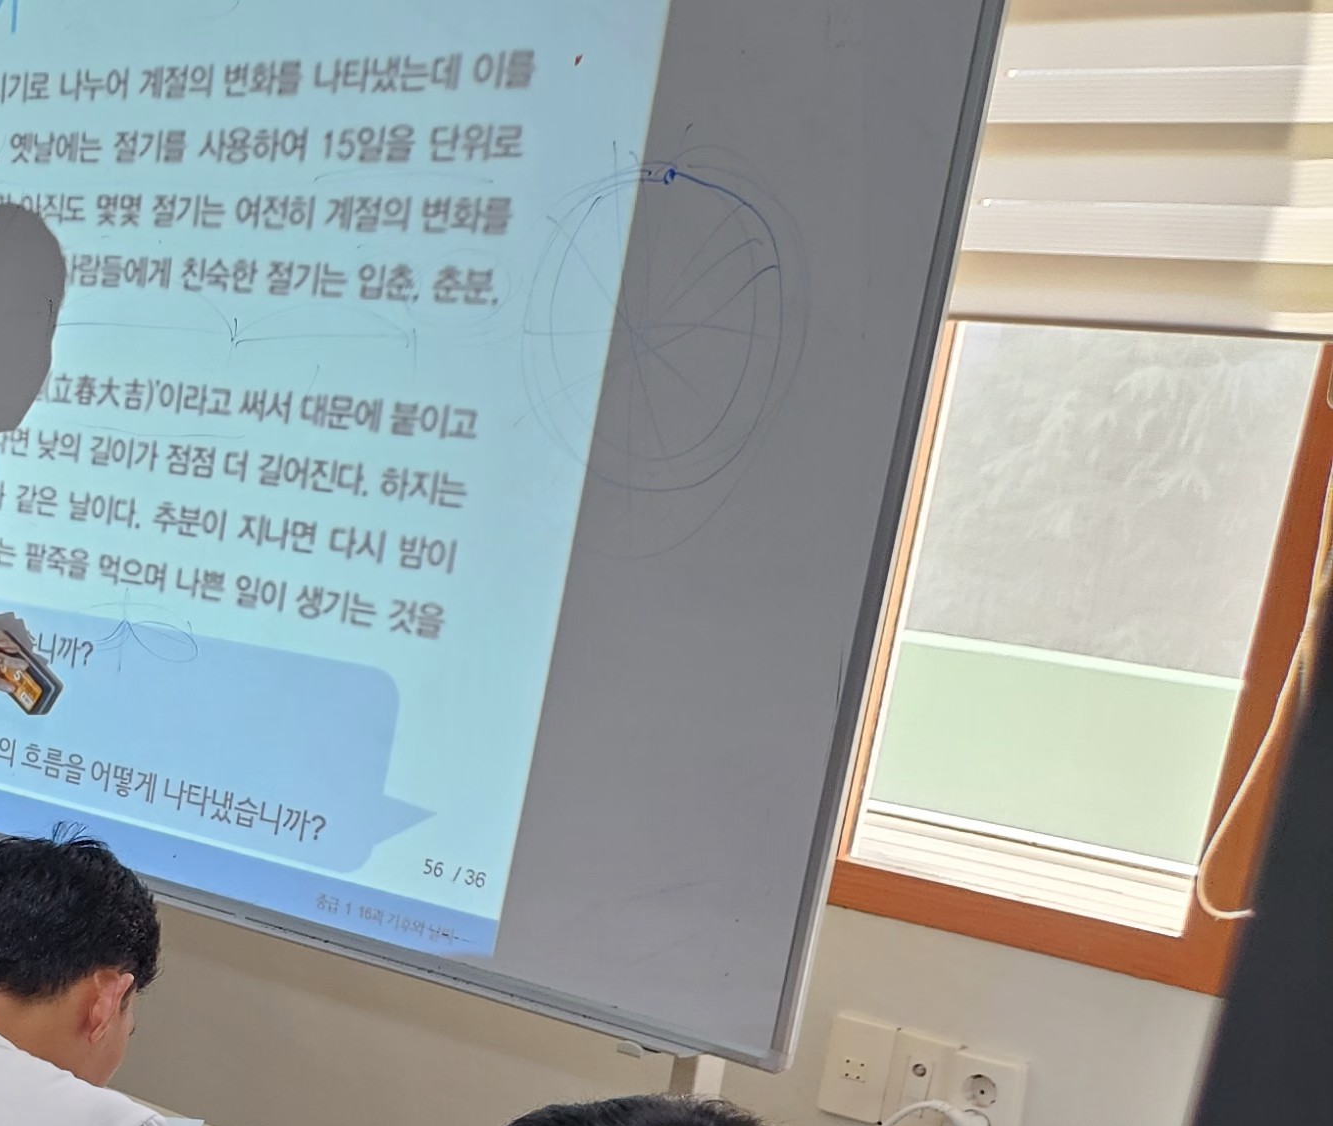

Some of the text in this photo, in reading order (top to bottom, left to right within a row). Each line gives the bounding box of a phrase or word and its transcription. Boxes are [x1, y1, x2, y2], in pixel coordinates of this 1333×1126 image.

[59, 66, 130, 102] 나누어
[138, 63, 215, 100] 계절의
[223, 59, 303, 99] 변화를
[312, 52, 464, 95] 나타냈는데
[472, 48, 536, 90] 이를
[9, 131, 103, 165] 옛날에는
[113, 129, 187, 165] 절기를
[197, 126, 309, 166] 사용하여
[323, 123, 416, 164] 15일을
[428, 123, 524, 163] 단위로
[95, 193, 143, 228] 몇몇
[151, 193, 227, 230] 절기는
[234, 194, 317, 231] 여전히
[324, 195, 413, 234] 계절의
[420, 195, 513, 236] 변화를
[180, 256, 259, 295] 친숙한
[265, 260, 349, 299] 절기는
[238, 388, 294, 425] 써서
[299, 393, 385, 434] 대문에
[389, 400, 479, 440] 붙이고
[38, 430, 81, 463] 낮의
[90, 436, 159, 472] 길이가
[166, 443, 216, 479] 점점
[223, 449, 250, 485] 더
[258, 452, 369, 499] 길어진다.
[381, 465, 468, 511] 하지는
[16, 484, 58, 518] 같은
[69, 491, 140, 530] 날이다.
[153, 498, 228, 543] 추분이
[238, 512, 318, 555] 지나면
[330, 523, 387, 566] 다시
[399, 533, 458, 576] 밤이
[25, 541, 90, 582] 팥죽을
[99, 553, 167, 593] 먹으며
[176, 567, 226, 604] 나쁜
[235, 572, 287, 614] 일이
[296, 583, 377, 629] 생기는
[389, 597, 447, 642] 것을
[32, 633, 94, 669] 니까?
[21, 743, 86, 786] 흐름을
[91, 760, 157, 804] 어떻게
[163, 777, 328, 845] 나타냈습니까?
[422, 858, 445, 878] 56
